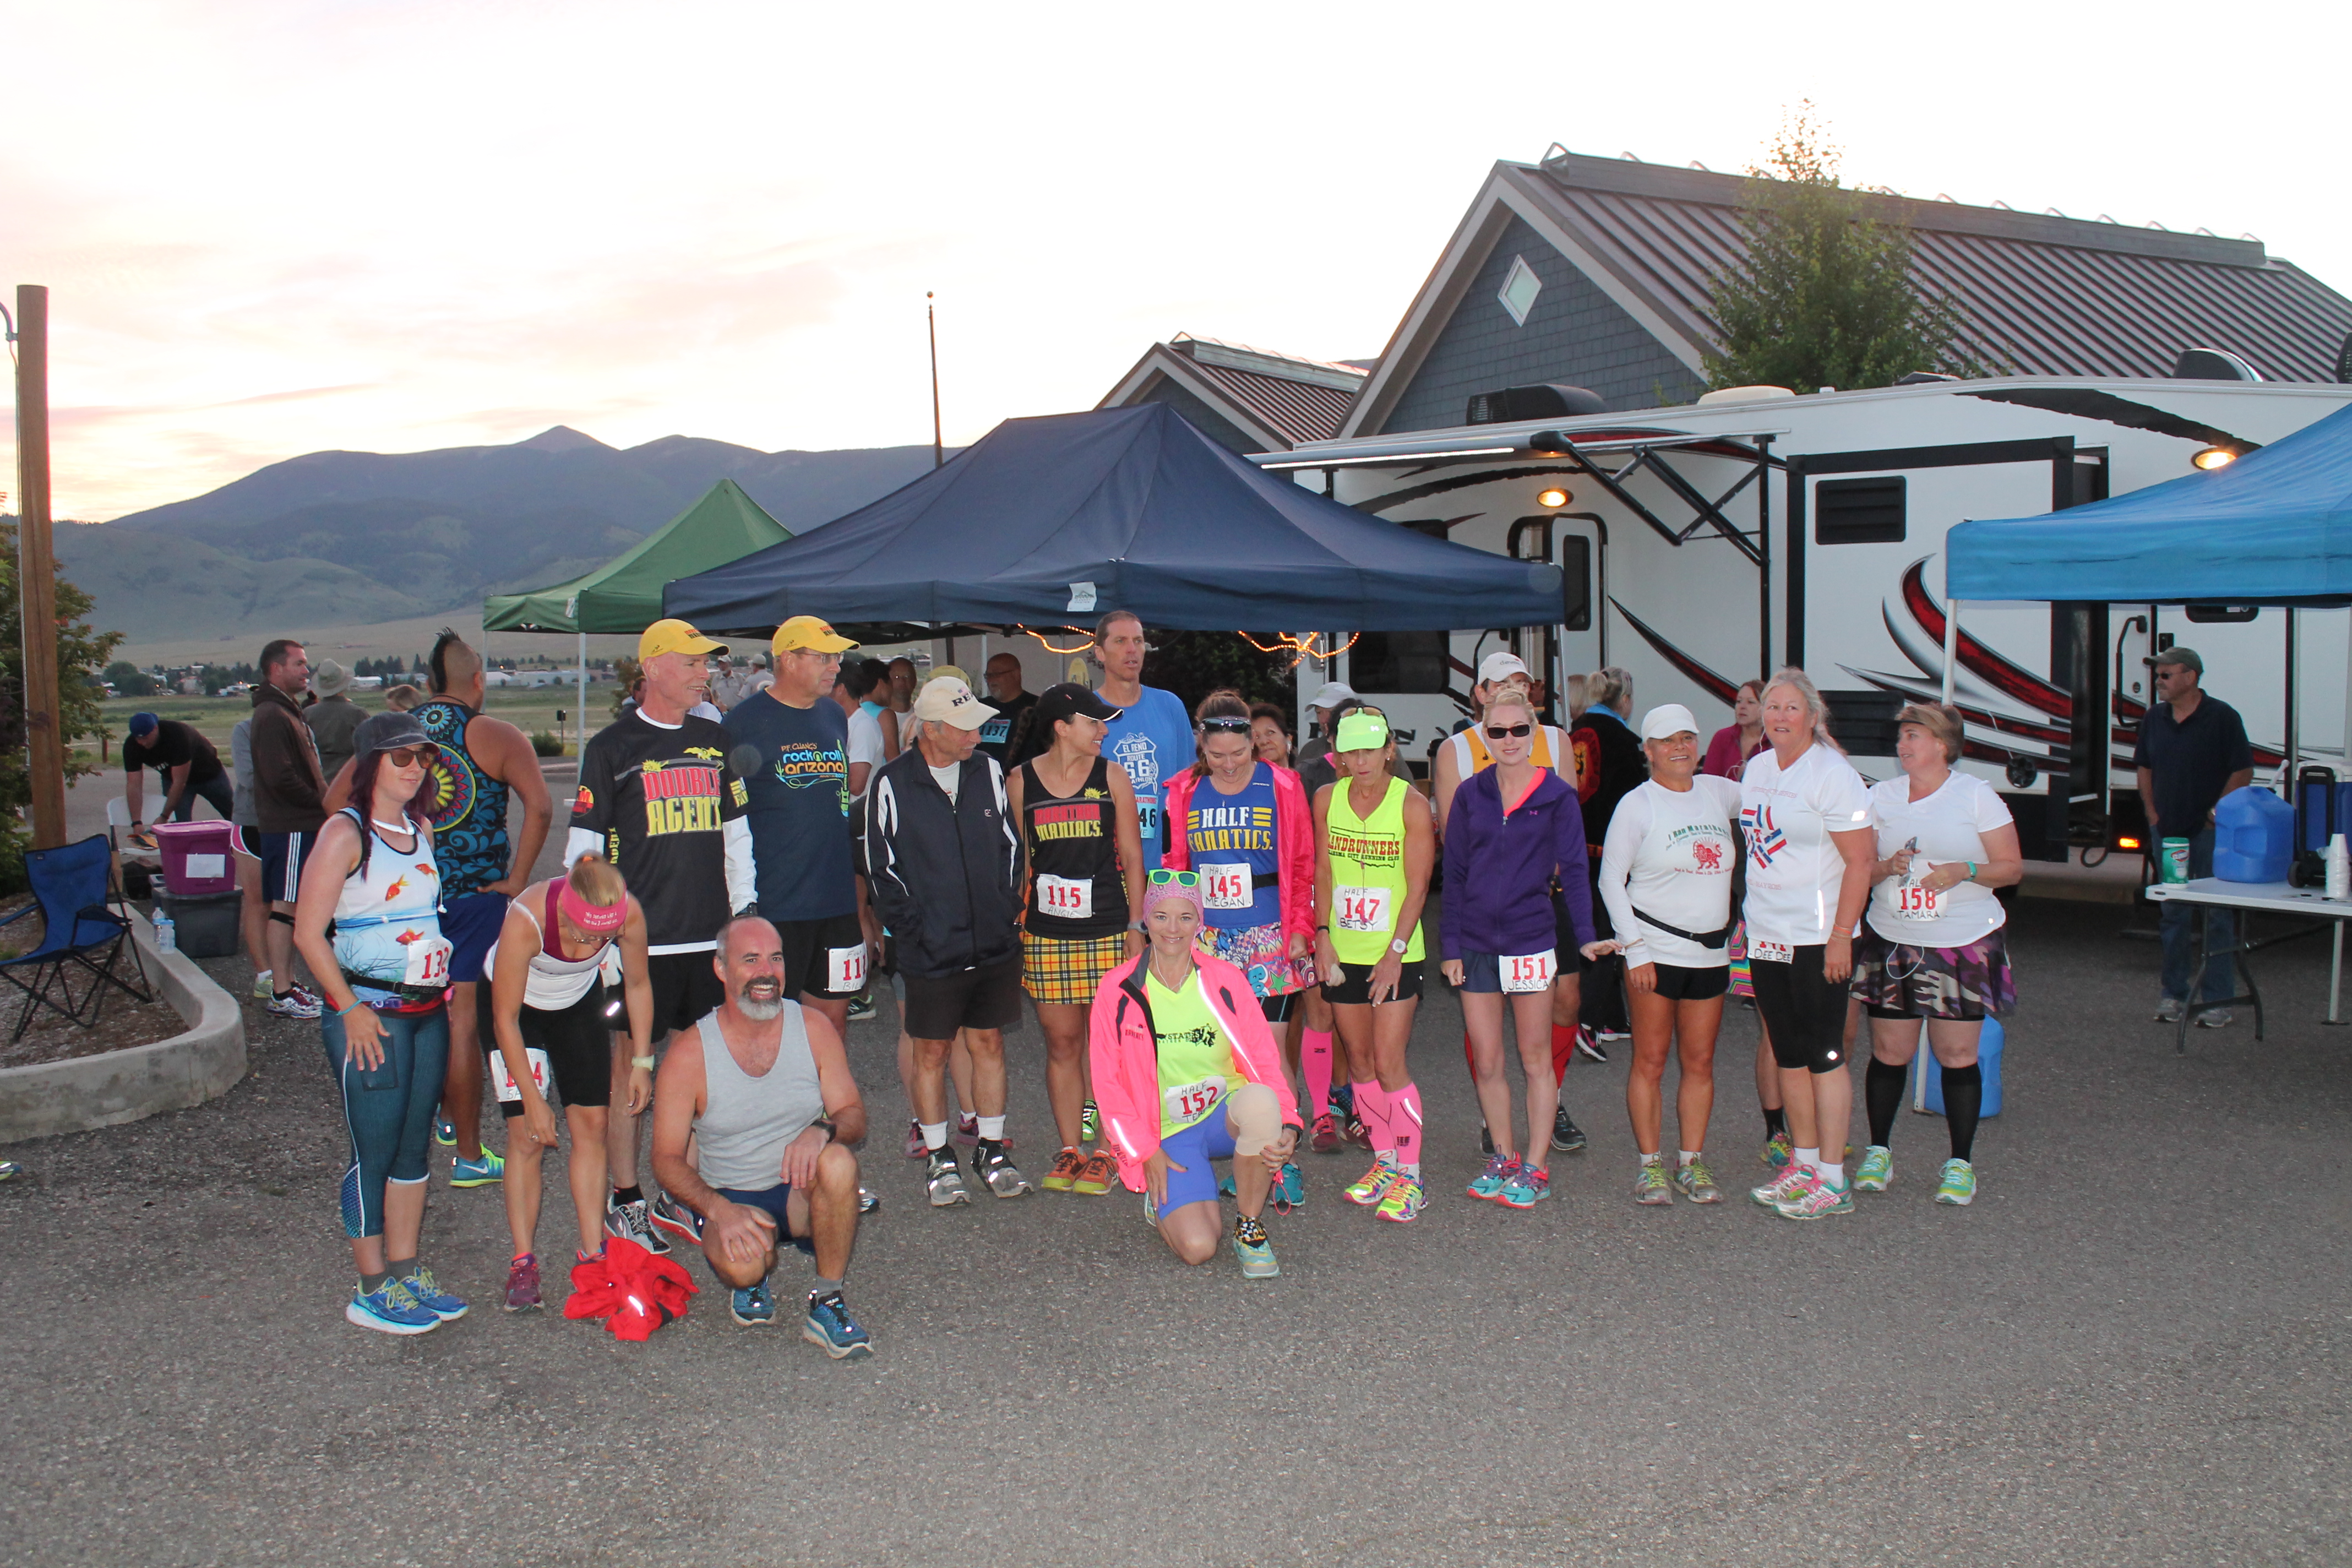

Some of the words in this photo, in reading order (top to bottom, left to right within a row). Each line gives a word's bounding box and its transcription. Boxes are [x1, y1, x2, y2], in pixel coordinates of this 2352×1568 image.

[1122, 744, 1130, 753] EL
[1130, 742, 1147, 753] RENO
[783, 749, 814, 764] rock
[823, 749, 842, 761] roll
[1126, 753, 1145, 761] ROUTE
[785, 761, 844, 775] arizona
[640, 767, 722, 801] DOUBLE
[646, 796, 722, 837] AGENT
[1034, 804, 1101, 826] MARATHON
[1201, 807, 1250, 829] HALF
[1209, 866, 1233, 875] HALF
[1209, 875, 1242, 898] 145
[1344, 888, 1369, 896] HALF
[1048, 885, 1081, 908] 115
[1205, 896, 1245, 908] MEGAN
[1901, 888, 1936, 910] 158
[1048, 906, 1077, 918] ANGIE
[1344, 897, 1380, 921] 147
[1897, 910, 1941, 919] TAMARA
[1340, 917, 1378, 931] BETSY
[421, 946, 450, 979] 132
[1754, 948, 1774, 960] DEE
[1776, 951, 1792, 962] DEE
[1512, 956, 1548, 981] 151
[1507, 979, 1550, 990] JESSICA
[1182, 1080, 1207, 1095] HALF
[1180, 1086, 1218, 1115] 152
